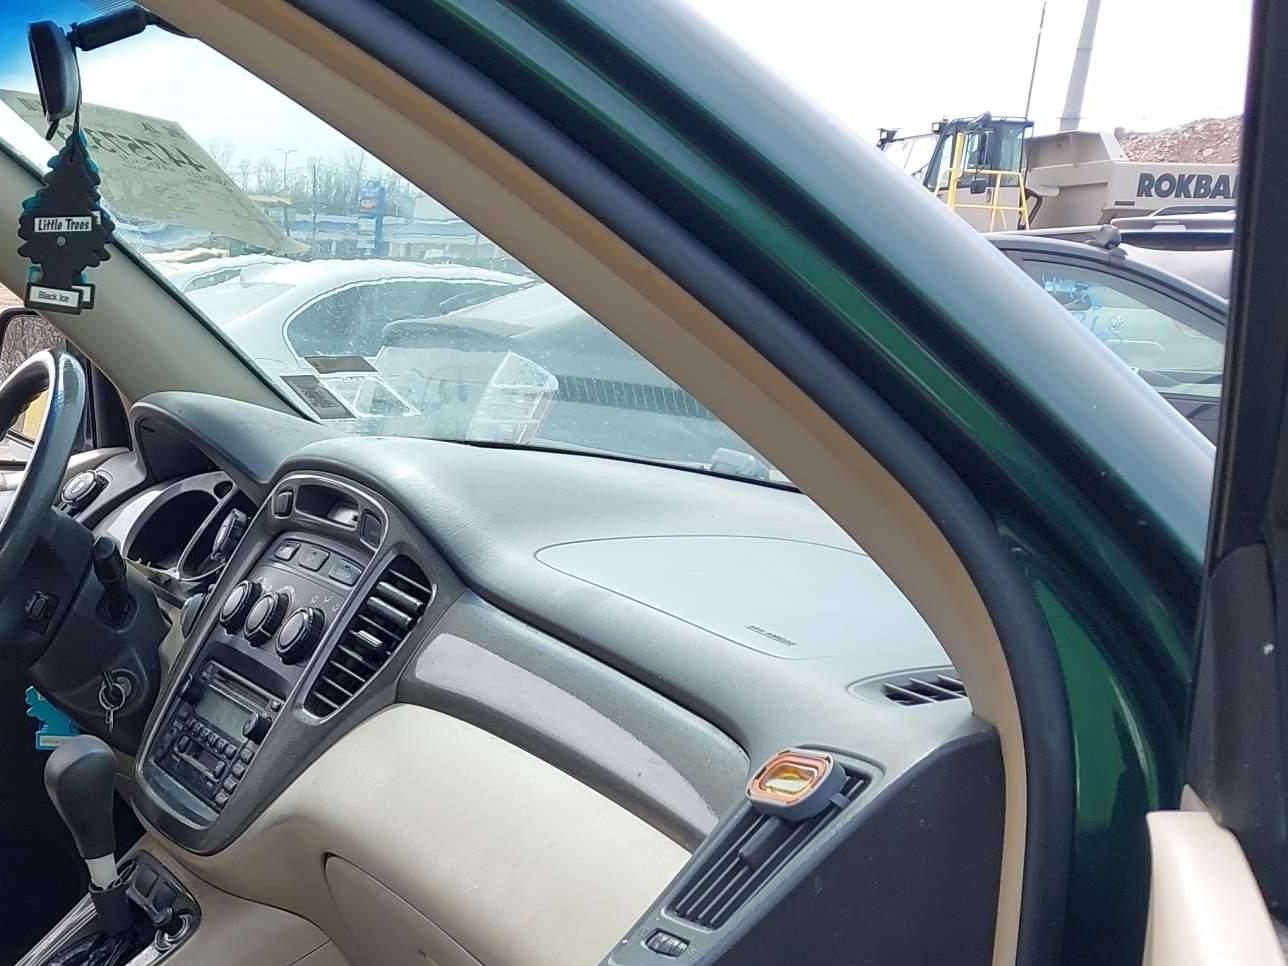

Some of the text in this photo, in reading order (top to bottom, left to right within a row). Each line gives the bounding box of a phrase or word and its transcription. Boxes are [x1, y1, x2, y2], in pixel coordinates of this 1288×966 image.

[38, 217, 90, 231] Little Trees
[37, 290, 71, 304] Black Ice
